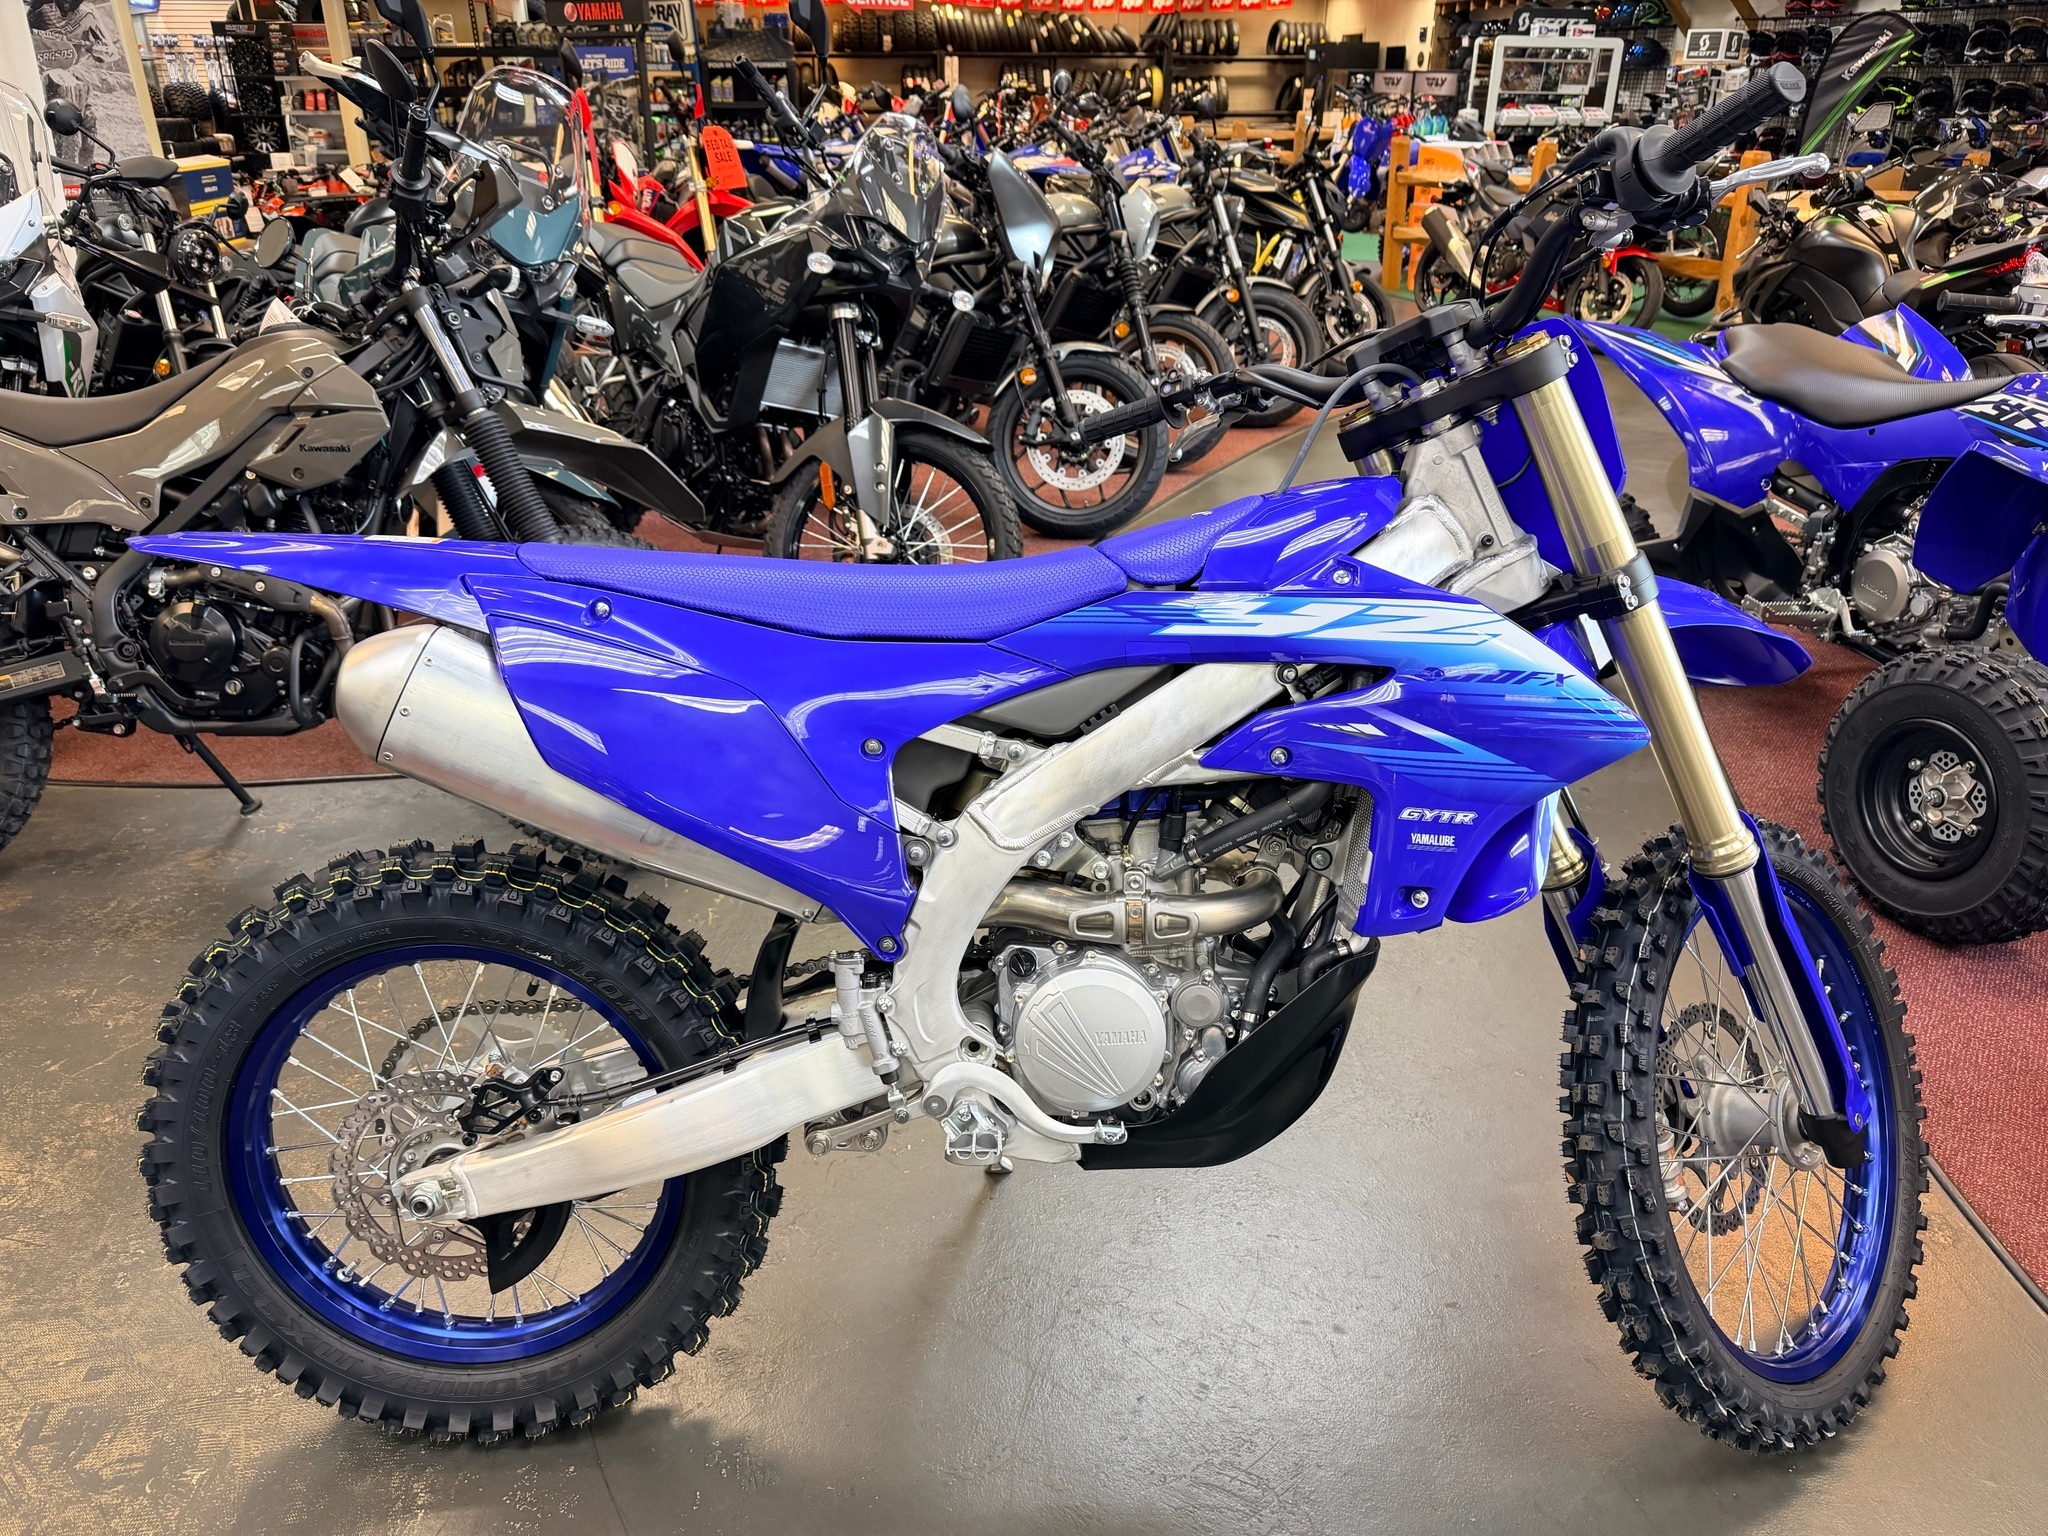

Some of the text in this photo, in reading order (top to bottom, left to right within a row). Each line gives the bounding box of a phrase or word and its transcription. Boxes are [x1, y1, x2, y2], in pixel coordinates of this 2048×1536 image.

[577, 3, 624, 20] YAMAHA
[1841, 29, 1893, 81] Kawasaki
[604, 58, 625, 69] RIDE
[705, 138, 734, 151] RED TAG
[714, 152, 732, 163] SALE
[739, 260, 791, 296] KLE
[299, 444, 351, 452] Kawasaki
[1398, 807, 1478, 825] GYTR
[1411, 833, 1456, 847] YAMALUBE
[482, 926, 649, 1021] DUNLOP
[1095, 1030, 1147, 1046] YAMAHA
